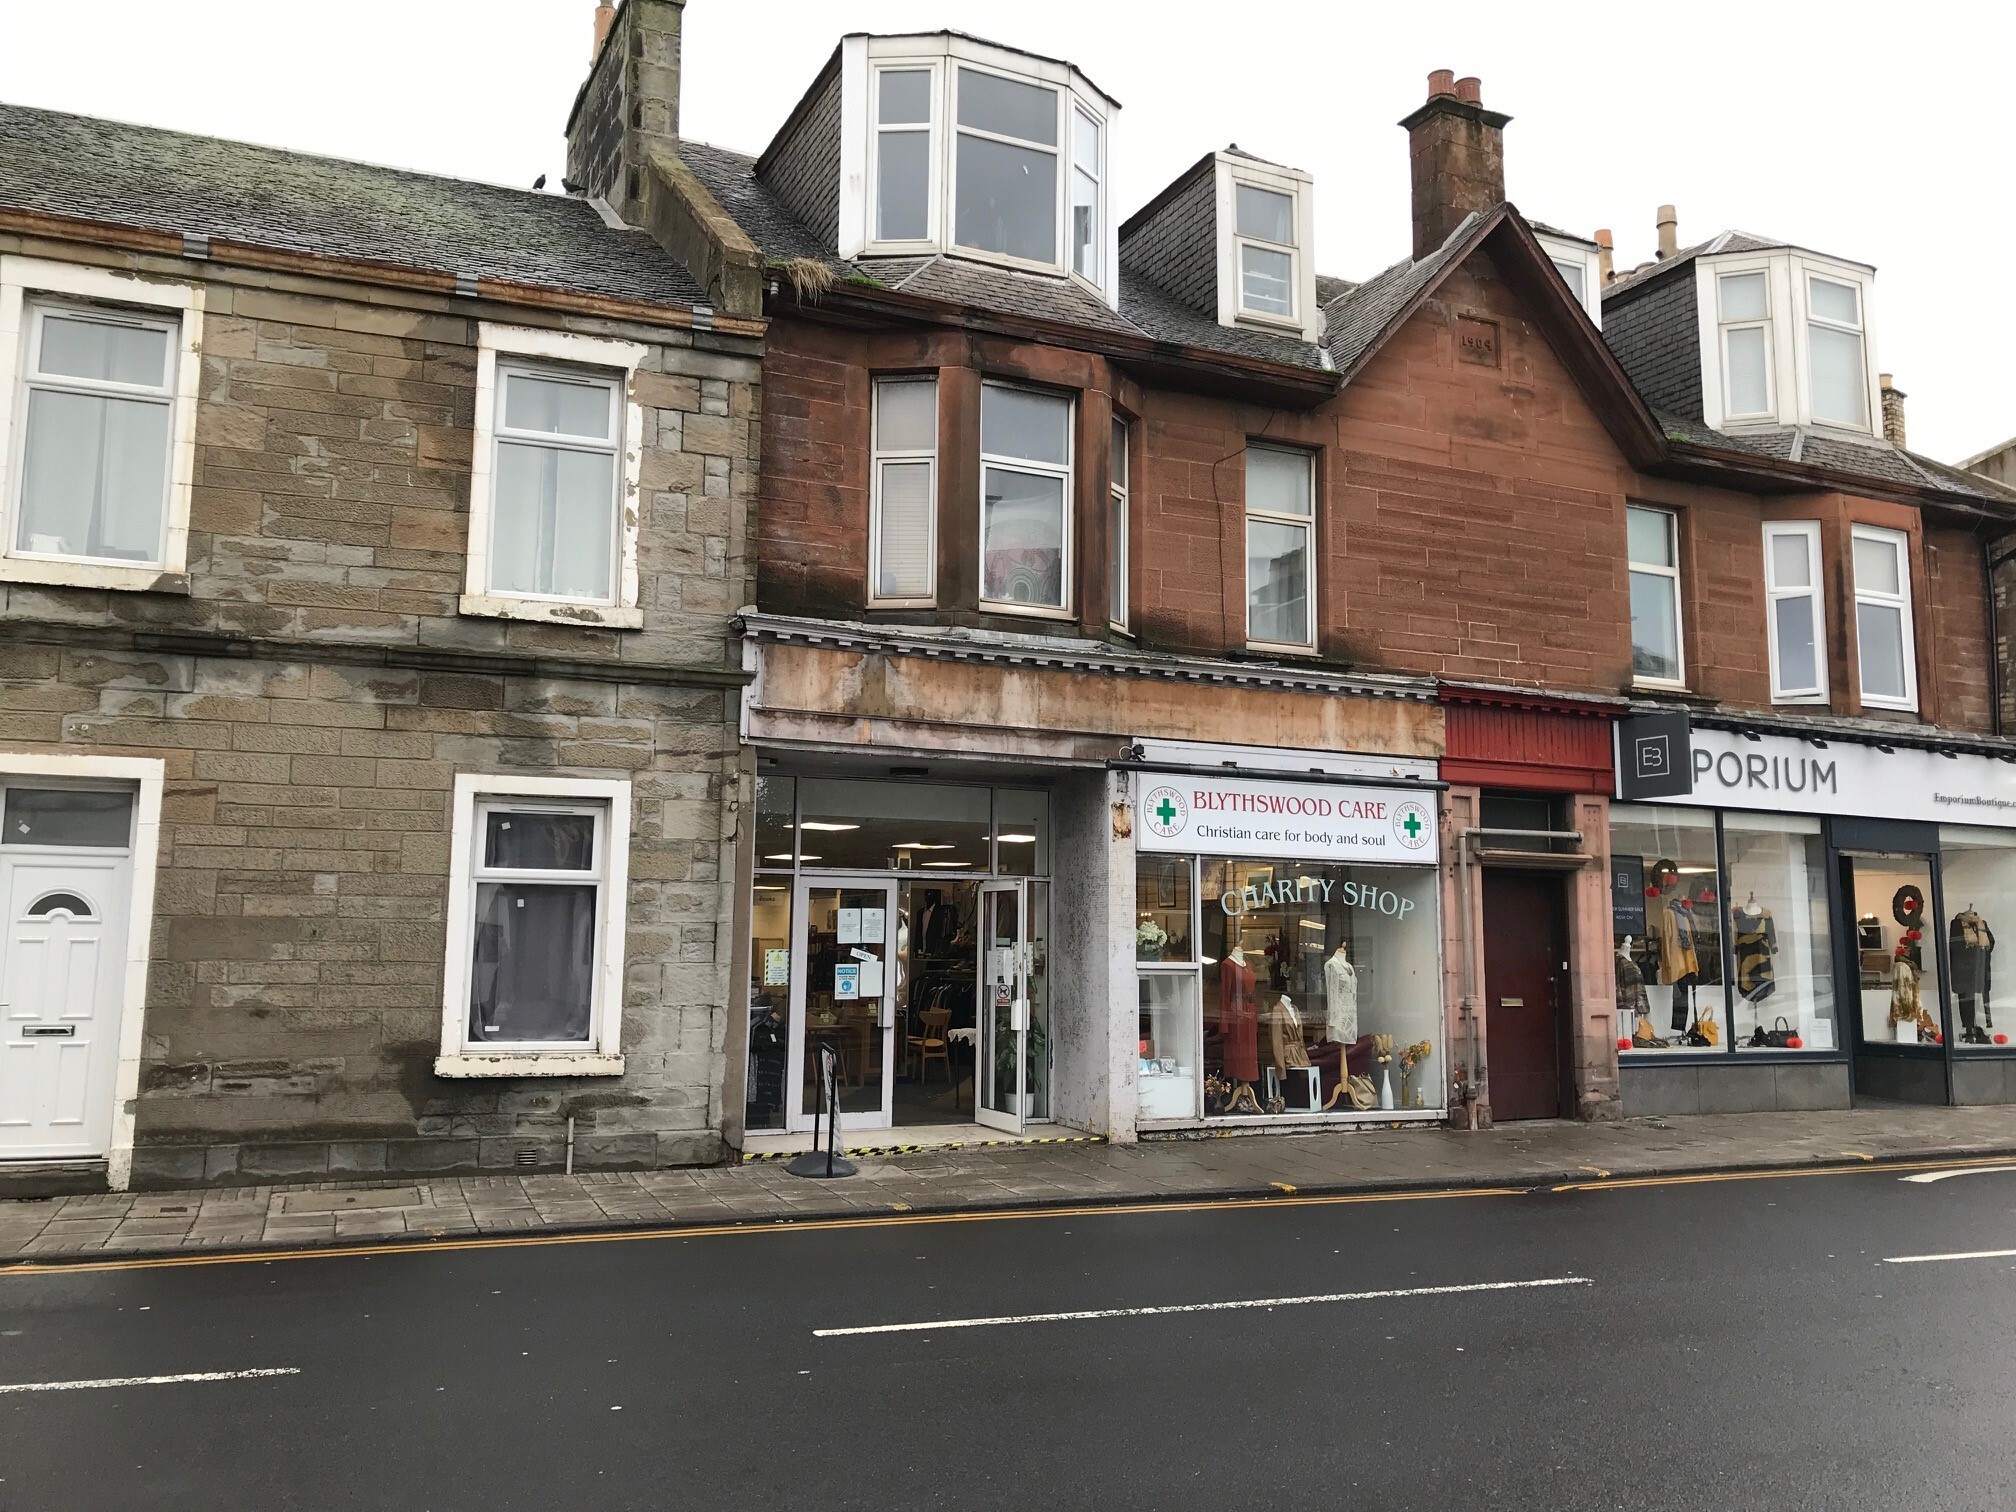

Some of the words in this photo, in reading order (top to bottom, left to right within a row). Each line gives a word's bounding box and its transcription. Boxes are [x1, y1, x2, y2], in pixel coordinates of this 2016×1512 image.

[1692, 748, 1838, 794] PORIUM
[1146, 788, 1186, 817] BLYTHSWOOD
[1193, 790, 1332, 817] BLYTHSWOOD
[1338, 799, 1388, 820] CARE
[1153, 821, 1181, 836] CARE
[1395, 804, 1430, 830] BLYTHSWOOD
[1196, 824, 1251, 840] Christian
[1255, 830, 1281, 841] care
[1285, 829, 1301, 841] for
[1304, 830, 1333, 846] body
[1336, 833, 1358, 845] and
[1361, 835, 1386, 846] soul
[1401, 834, 1425, 848] CARE
[1220, 878, 1336, 916] CHARITY
[1342, 881, 1415, 921] SHOP
[856, 951, 872, 960] OPEN
